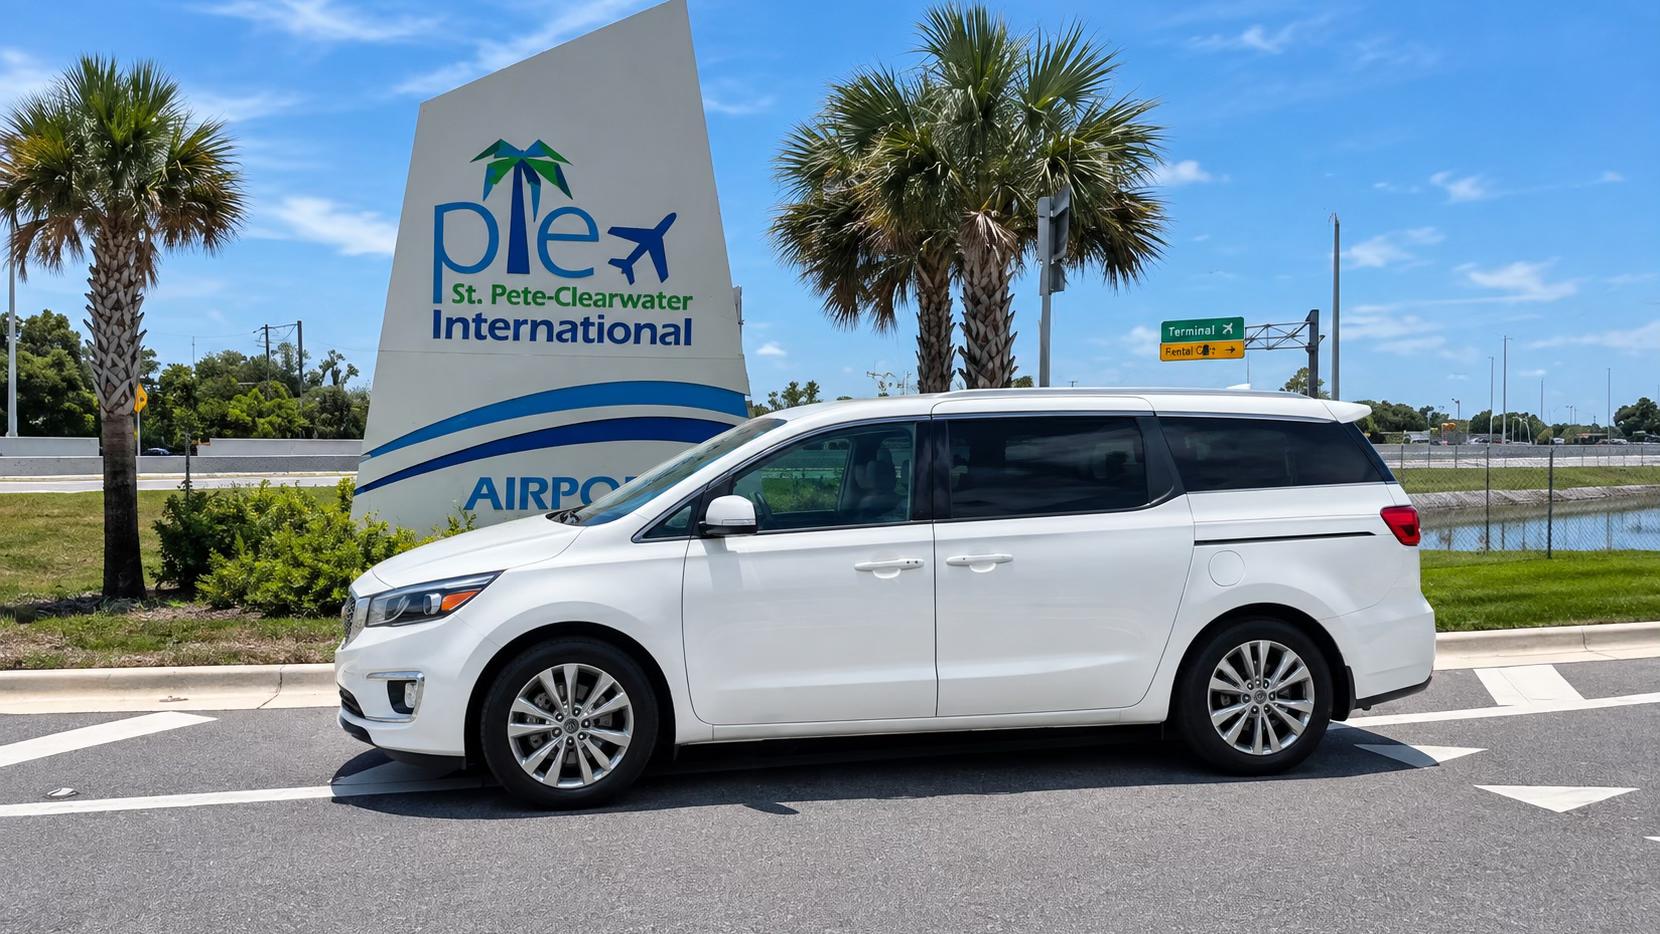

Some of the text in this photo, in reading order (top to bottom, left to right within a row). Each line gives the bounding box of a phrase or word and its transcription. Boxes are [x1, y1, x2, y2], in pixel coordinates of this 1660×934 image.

[451, 283, 693, 311] St. Pete-Clearwater
[432, 309, 693, 346] International
[1168, 325, 1215, 337] Terminal
[463, 476, 638, 510] AIRPO
